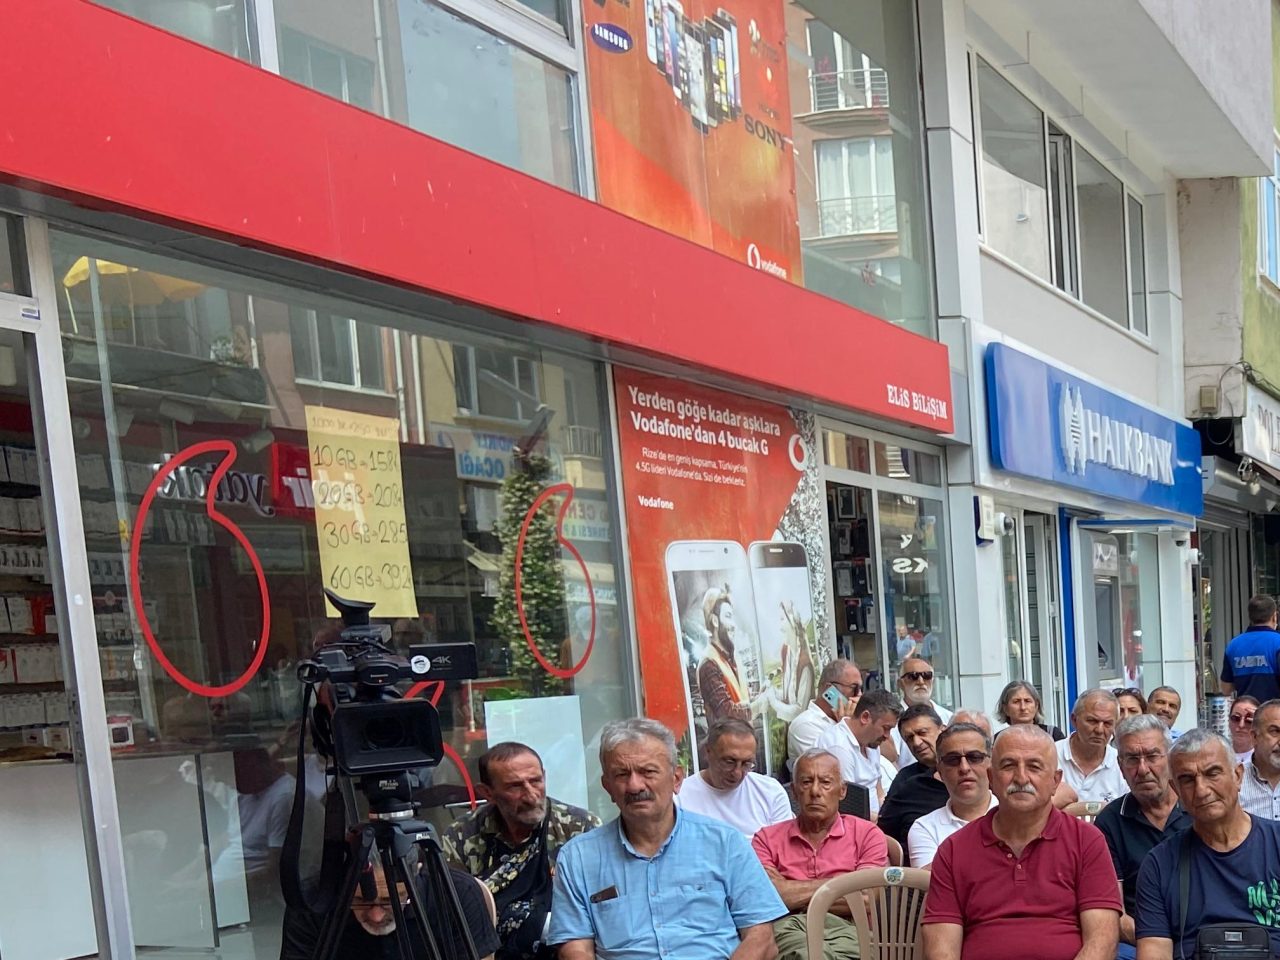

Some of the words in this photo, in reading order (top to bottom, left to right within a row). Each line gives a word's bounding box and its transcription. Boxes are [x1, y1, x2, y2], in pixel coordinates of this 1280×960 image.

[594, 23, 629, 51] SAMSUNG
[744, 114, 787, 151] SONY
[628, 385, 675, 413] Yerden
[677, 398, 707, 423] göğe
[708, 404, 742, 427] kadar
[743, 414, 781, 437] aşklara
[630, 410, 717, 446] Vodafone'dan
[718, 430, 727, 447] 4
[727, 431, 760, 454] bucak
[760, 439, 769, 456] G
[1085, 409, 1175, 486] HALKBANK
[638, 495, 675, 511] Vodafone
